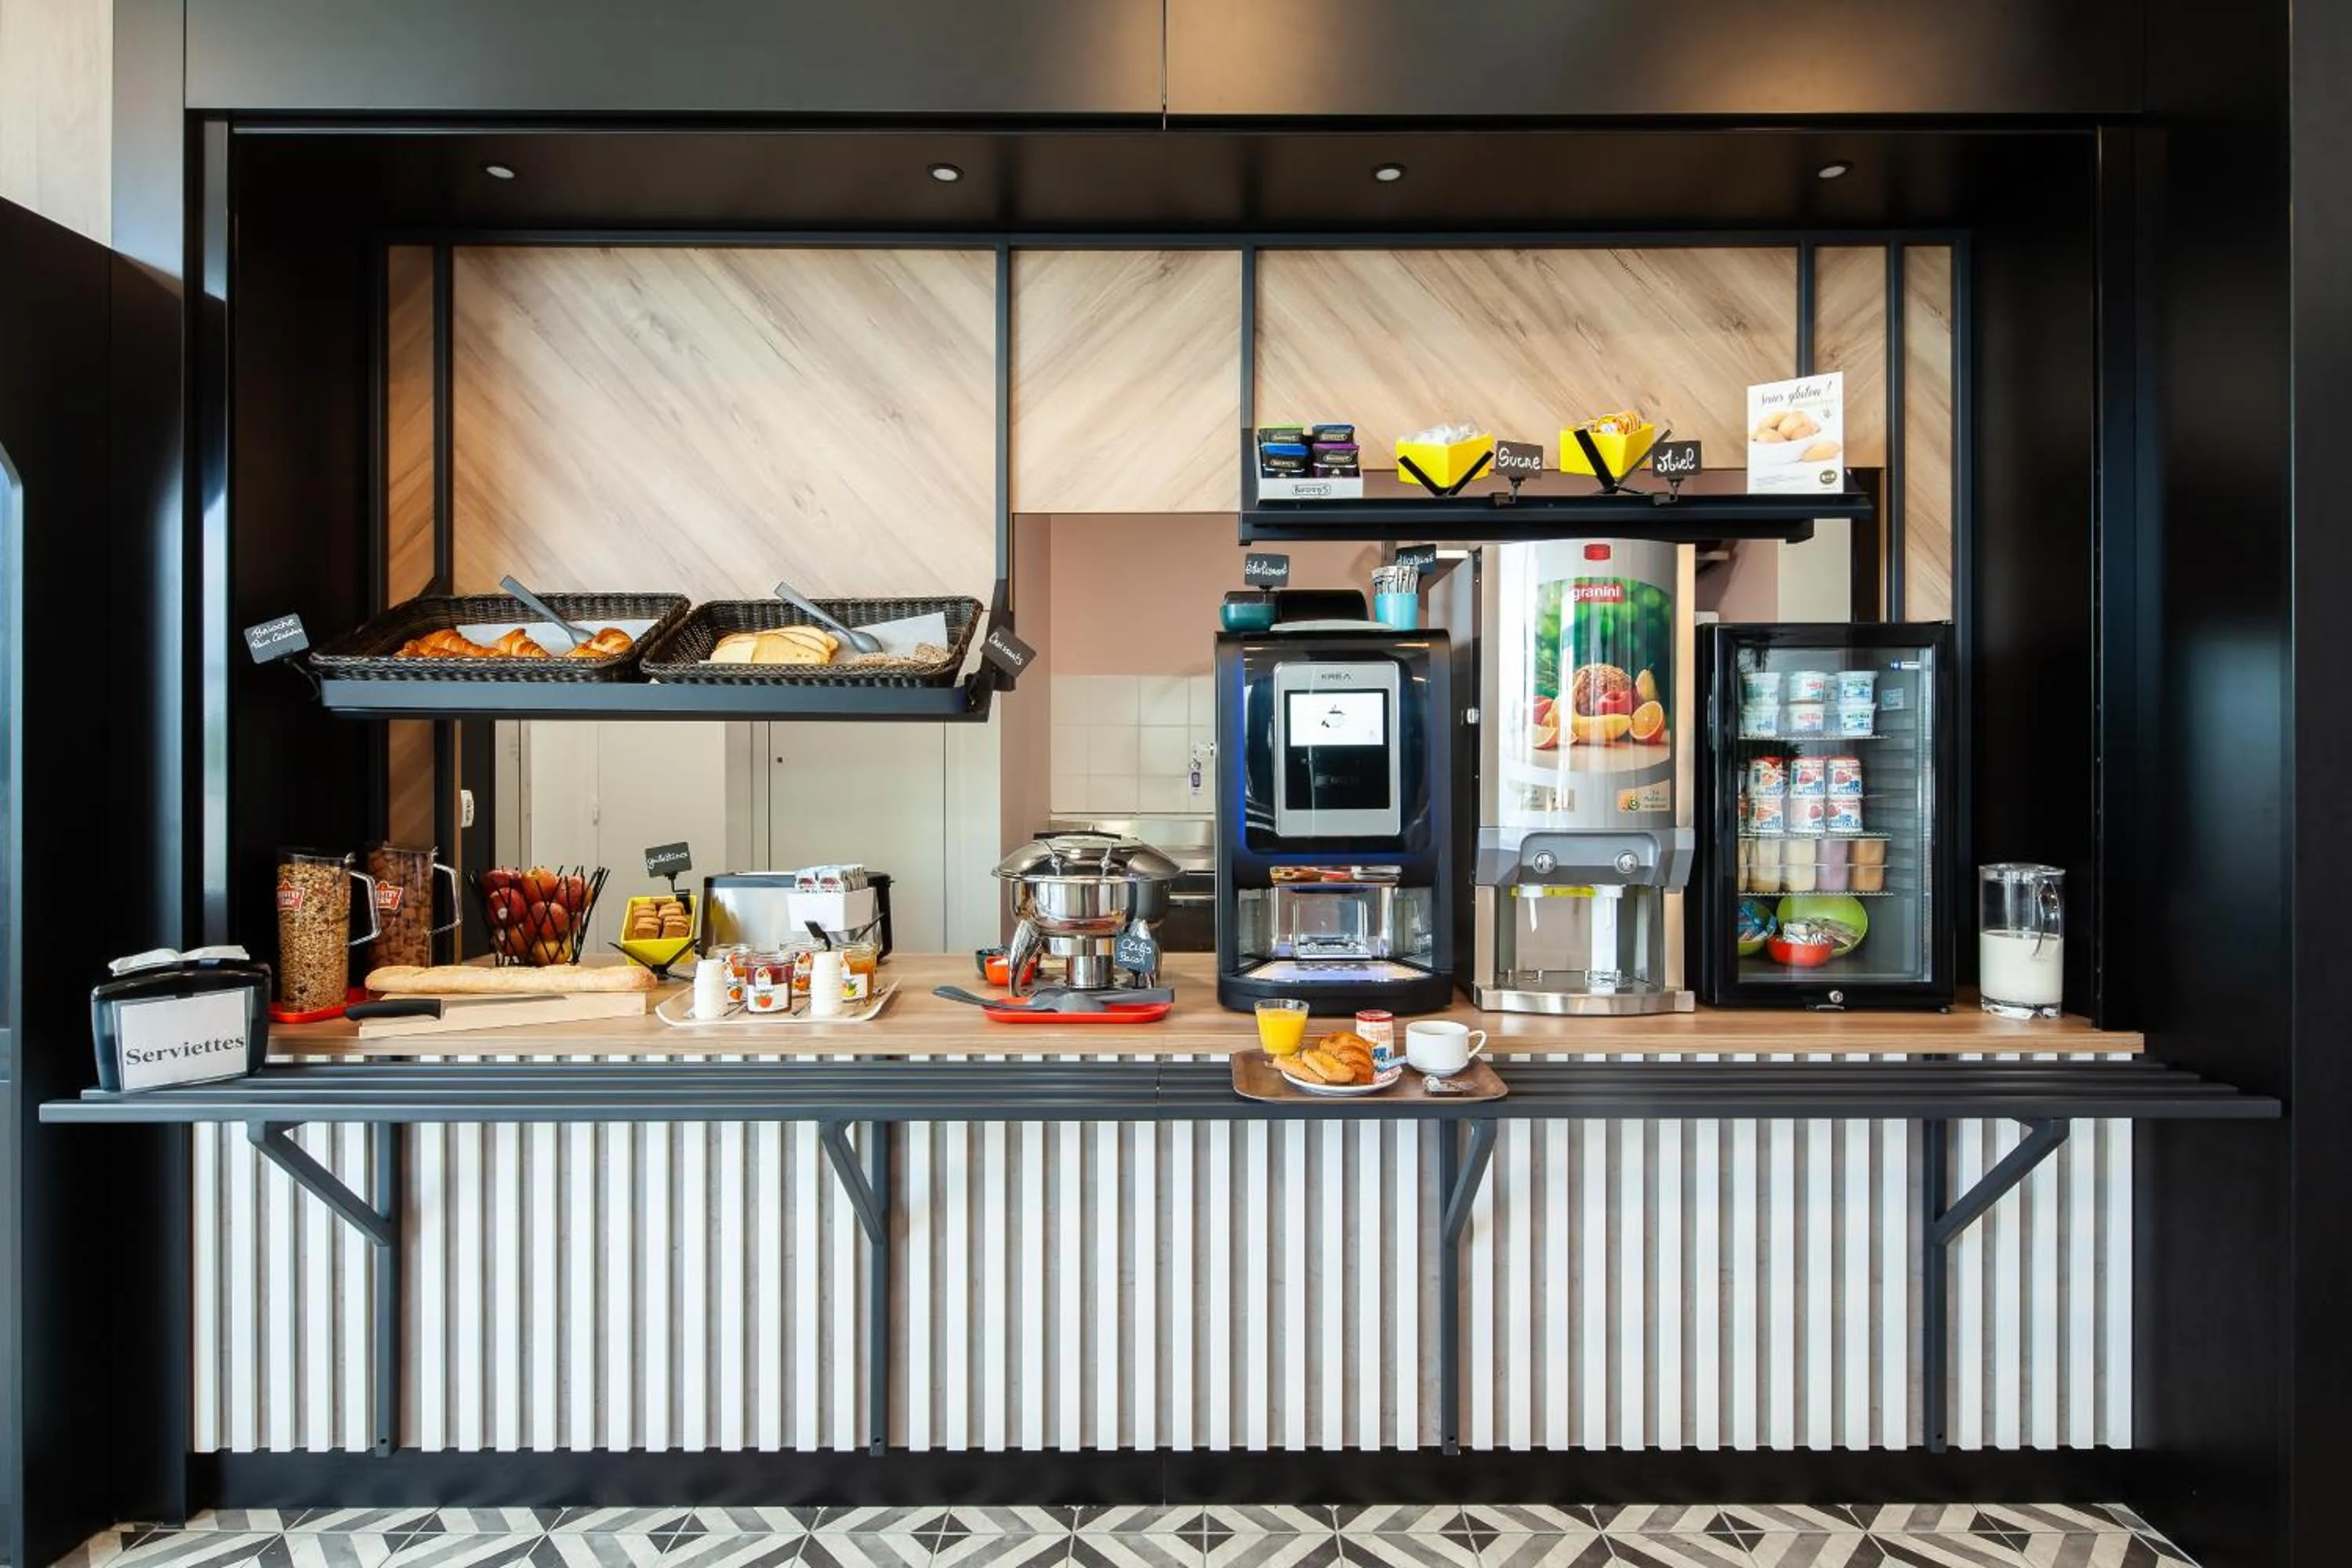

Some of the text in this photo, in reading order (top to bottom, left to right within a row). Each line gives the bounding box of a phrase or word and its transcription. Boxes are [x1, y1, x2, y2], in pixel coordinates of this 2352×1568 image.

[1498, 448, 1541, 470] Sucre
[1657, 448, 1696, 472] Miel
[1571, 585, 1620, 602] granini
[125, 1035, 245, 1066] Serviettes
